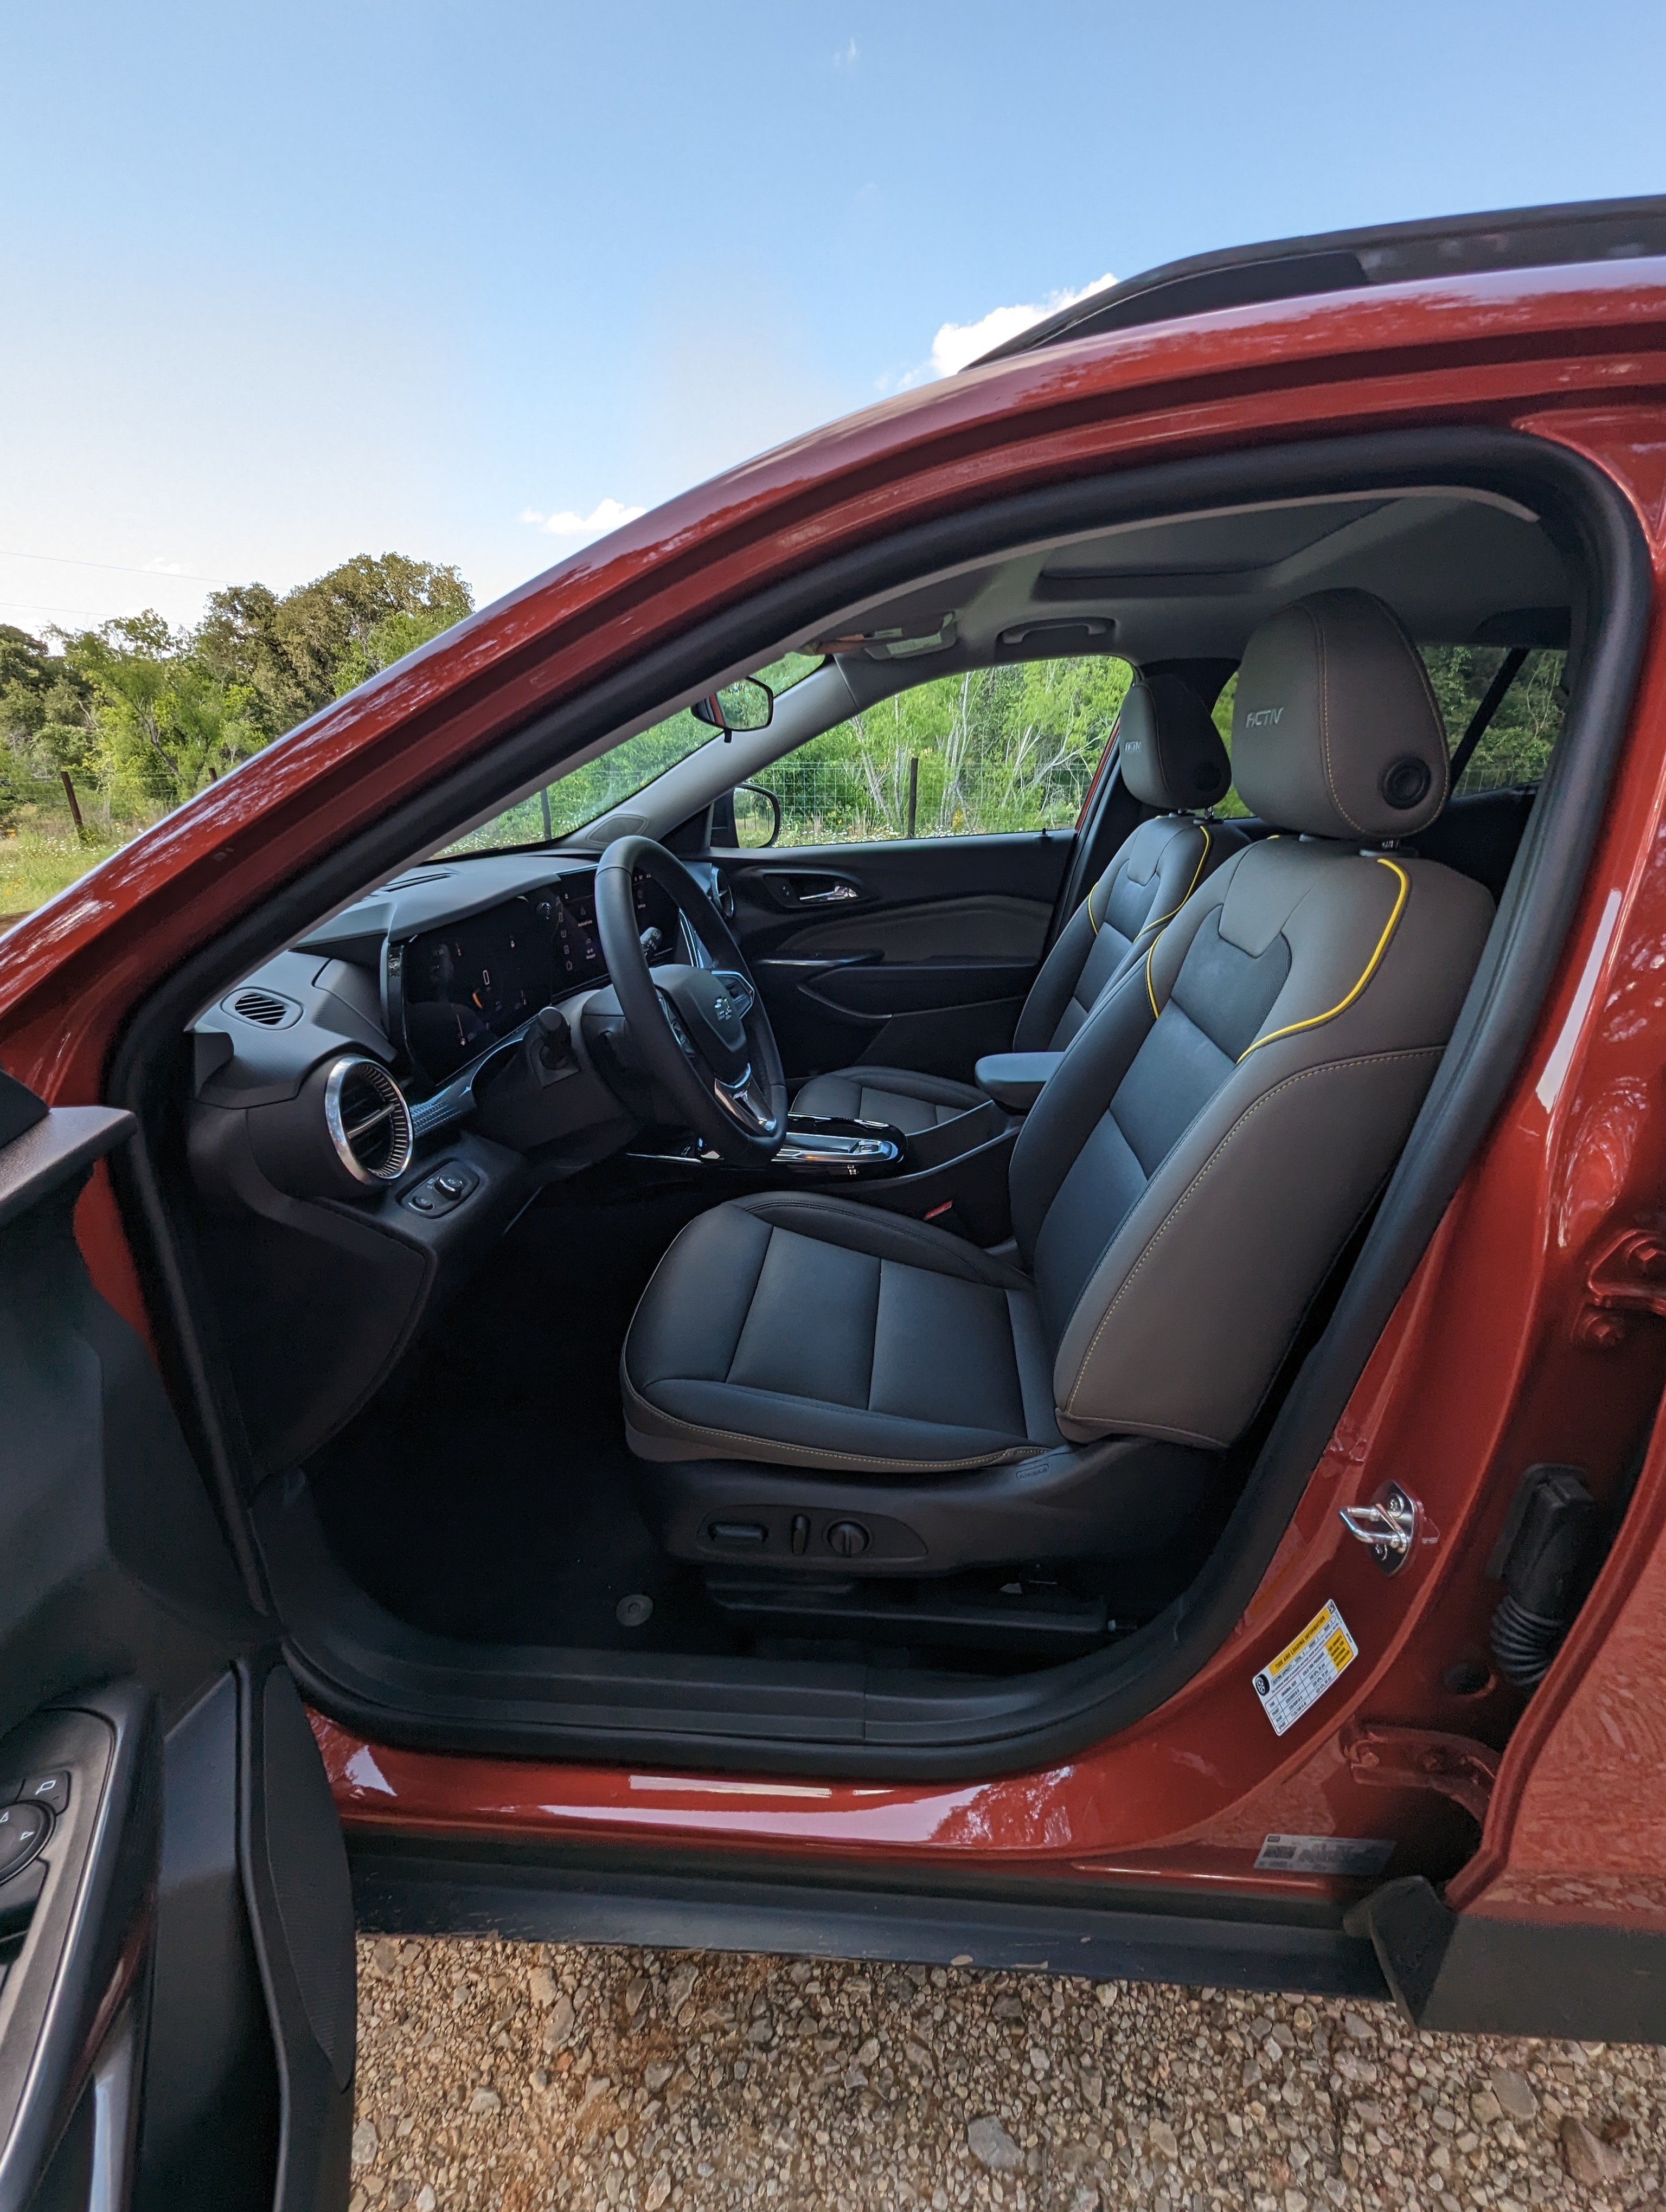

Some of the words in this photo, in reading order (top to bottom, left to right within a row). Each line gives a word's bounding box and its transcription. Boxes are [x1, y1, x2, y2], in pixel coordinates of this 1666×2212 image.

[1246, 707, 1283, 728] ACTIV
[1274, 1658, 1284, 1670] TIRE
[1282, 1650, 1291, 1662] AND
[1290, 1637, 1305, 1655] LOADING
[1303, 1614, 1326, 1641] INFORMATION
